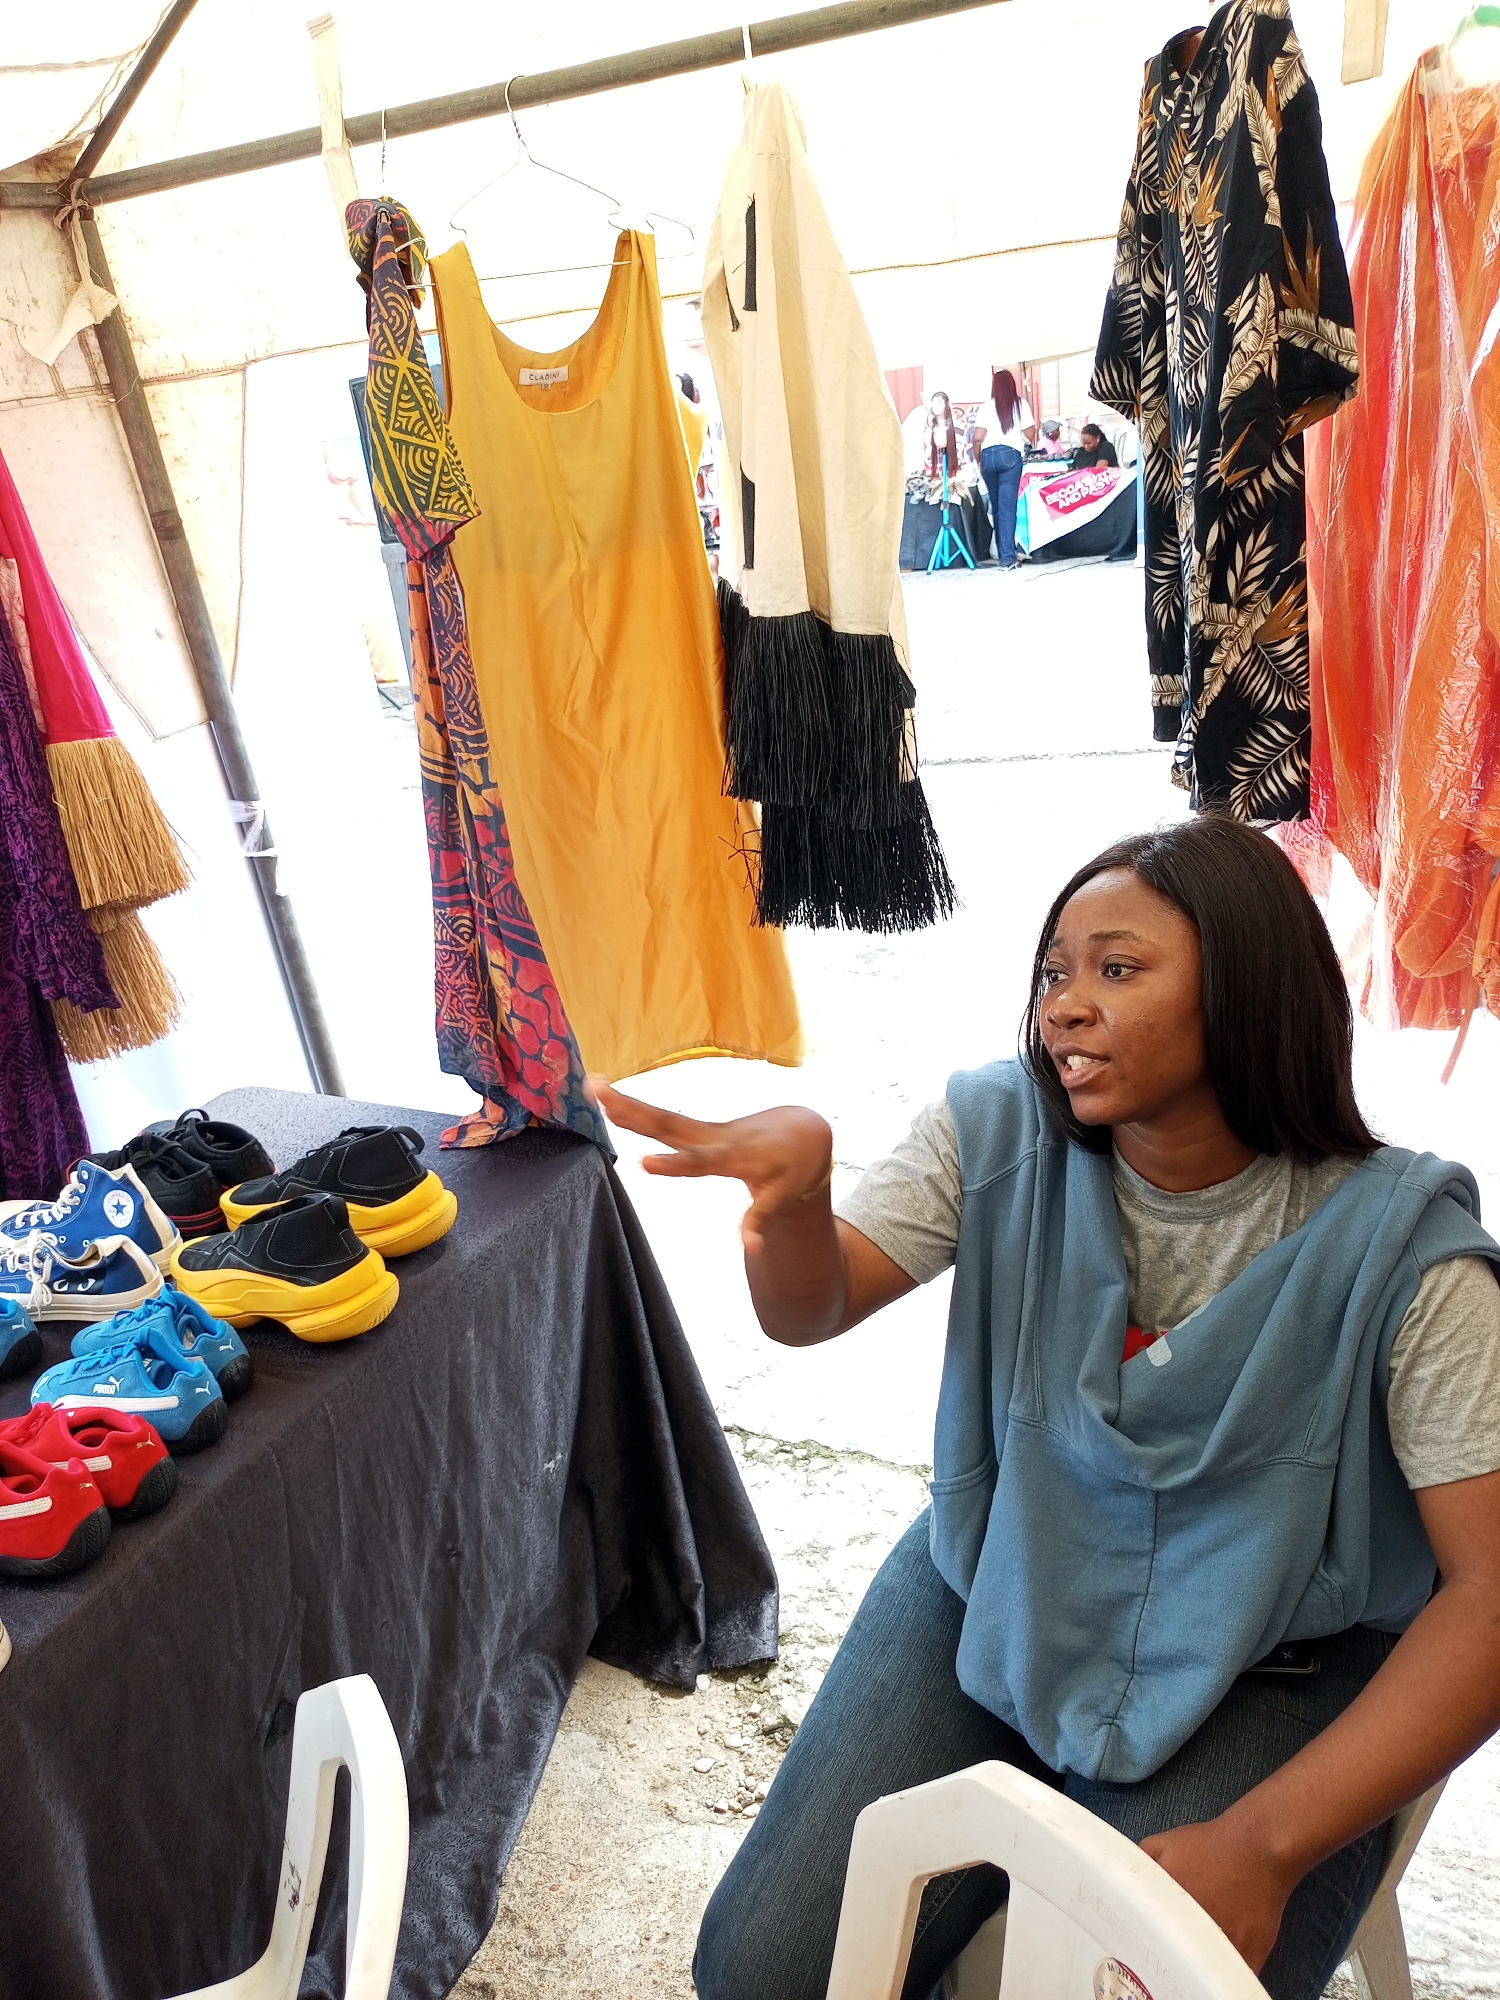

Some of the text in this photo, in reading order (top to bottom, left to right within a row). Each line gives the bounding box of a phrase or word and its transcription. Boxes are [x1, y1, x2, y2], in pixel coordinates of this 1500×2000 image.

[528, 372, 560, 381] CLADINI
[1058, 491, 1082, 509] AND
[92, 1383, 116, 1395] PUMA
